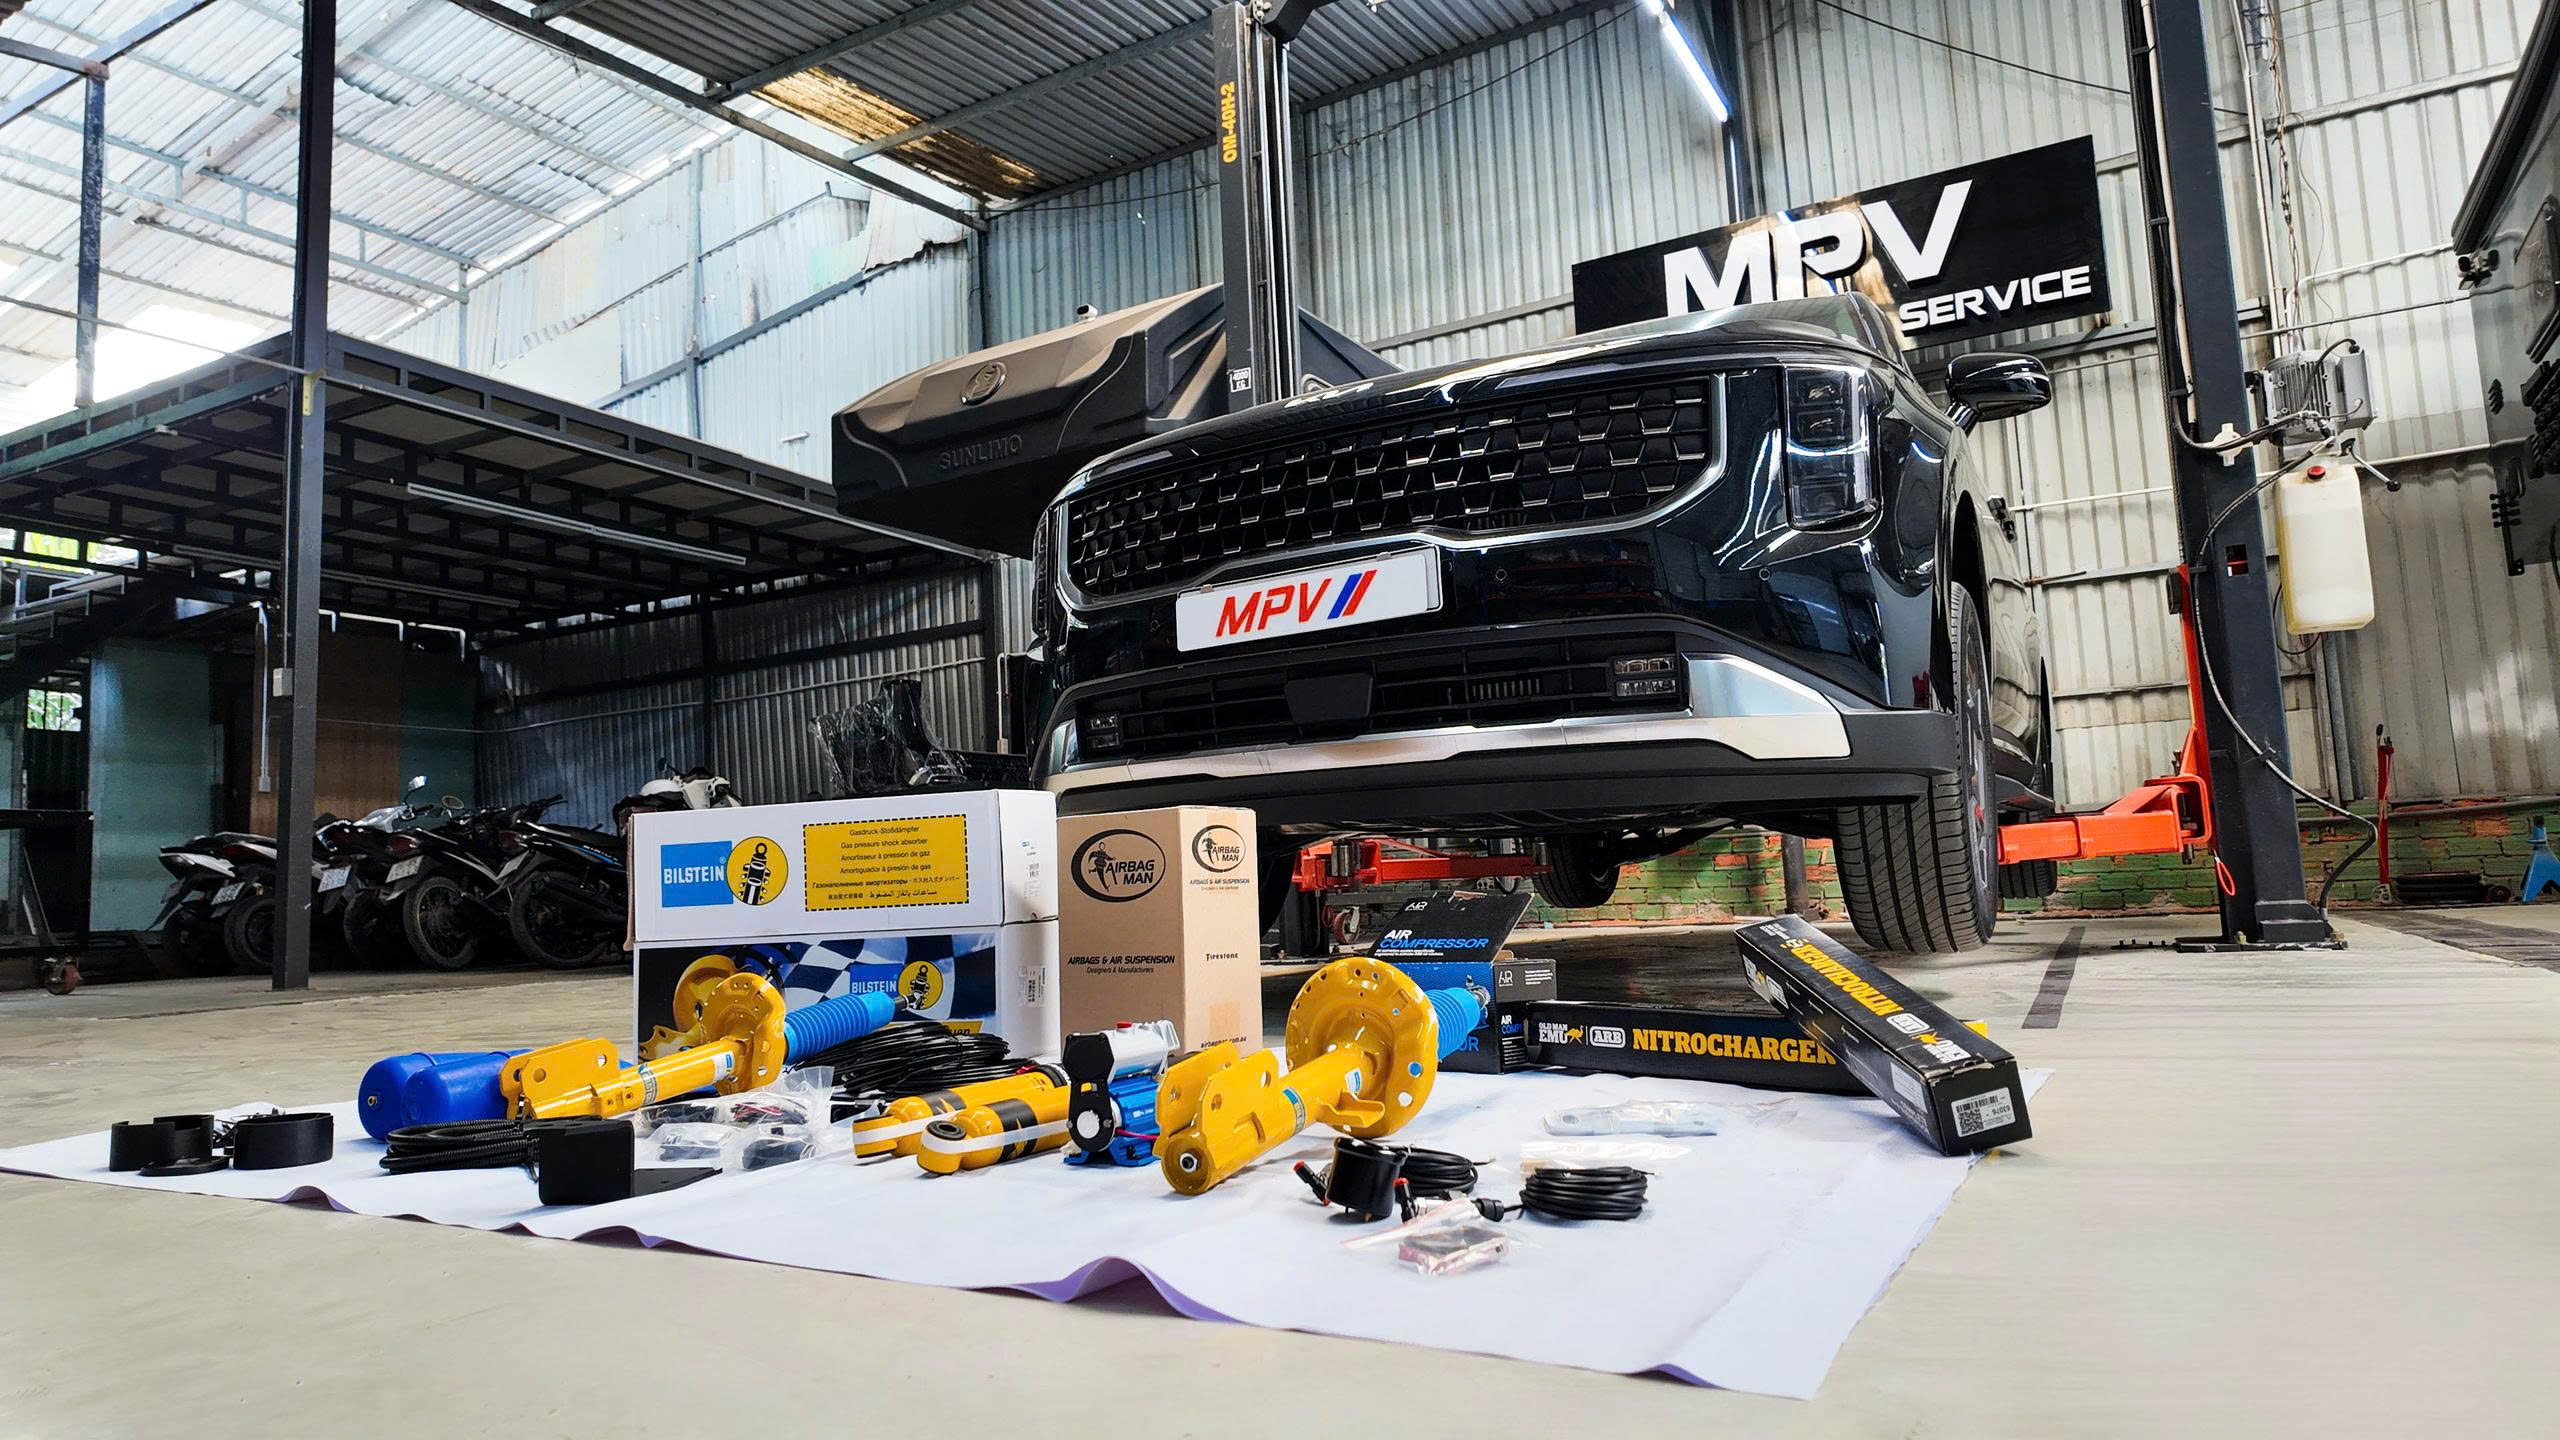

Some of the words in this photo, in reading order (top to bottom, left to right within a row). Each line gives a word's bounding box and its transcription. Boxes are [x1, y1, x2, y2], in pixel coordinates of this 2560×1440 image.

[1220, 81, 1238, 163] OM-40H-2
[1663, 179, 1973, 318] MPV
[1898, 265, 2092, 332] SERVICE
[938, 433, 1023, 470] SUNLIMO
[1215, 577, 1333, 638] MPV
[1211, 846, 1240, 854] AIRBAG
[1105, 859, 1156, 875] AIRBAG
[663, 865, 725, 884] BILSTEIN
[1122, 871, 1154, 885] MAN
[1384, 930, 1413, 939] AIR
[1379, 938, 1489, 949] COMPRESSOR
[1068, 956, 1100, 965] AIRBAGS
[1101, 956, 1107, 964] &
[1110, 956, 1123, 964] AIR
[1124, 955, 1175, 964] SUSPENSION
[1206, 953, 1239, 962] Firestone
[1087, 967, 1112, 975] Designers
[851, 980, 897, 993] BILSTEIN
[1501, 1014, 1512, 1025] AIR
[1539, 1022, 1552, 1030] OLD
[1552, 1023, 1568, 1031] MAN
[1539, 1029, 1568, 1044] EMU
